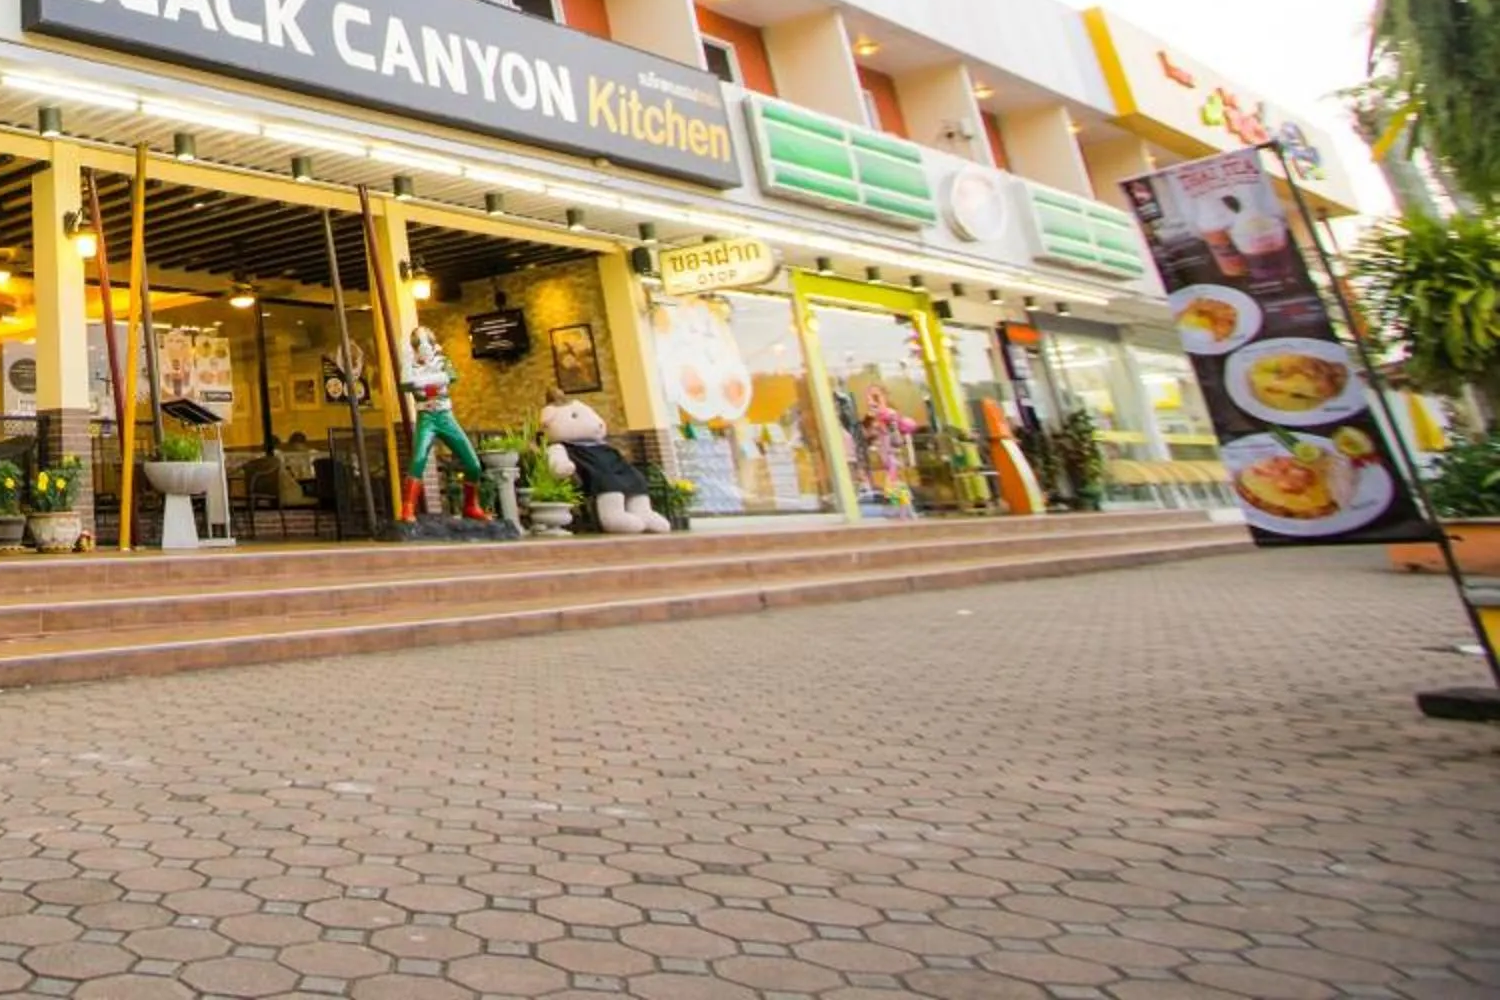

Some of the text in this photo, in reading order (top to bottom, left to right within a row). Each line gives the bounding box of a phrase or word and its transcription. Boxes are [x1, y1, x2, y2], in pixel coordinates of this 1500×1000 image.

[333, 1, 578, 122] CANYON
[588, 74, 731, 163] Kitchen
[668, 242, 761, 273] ของฝาก
